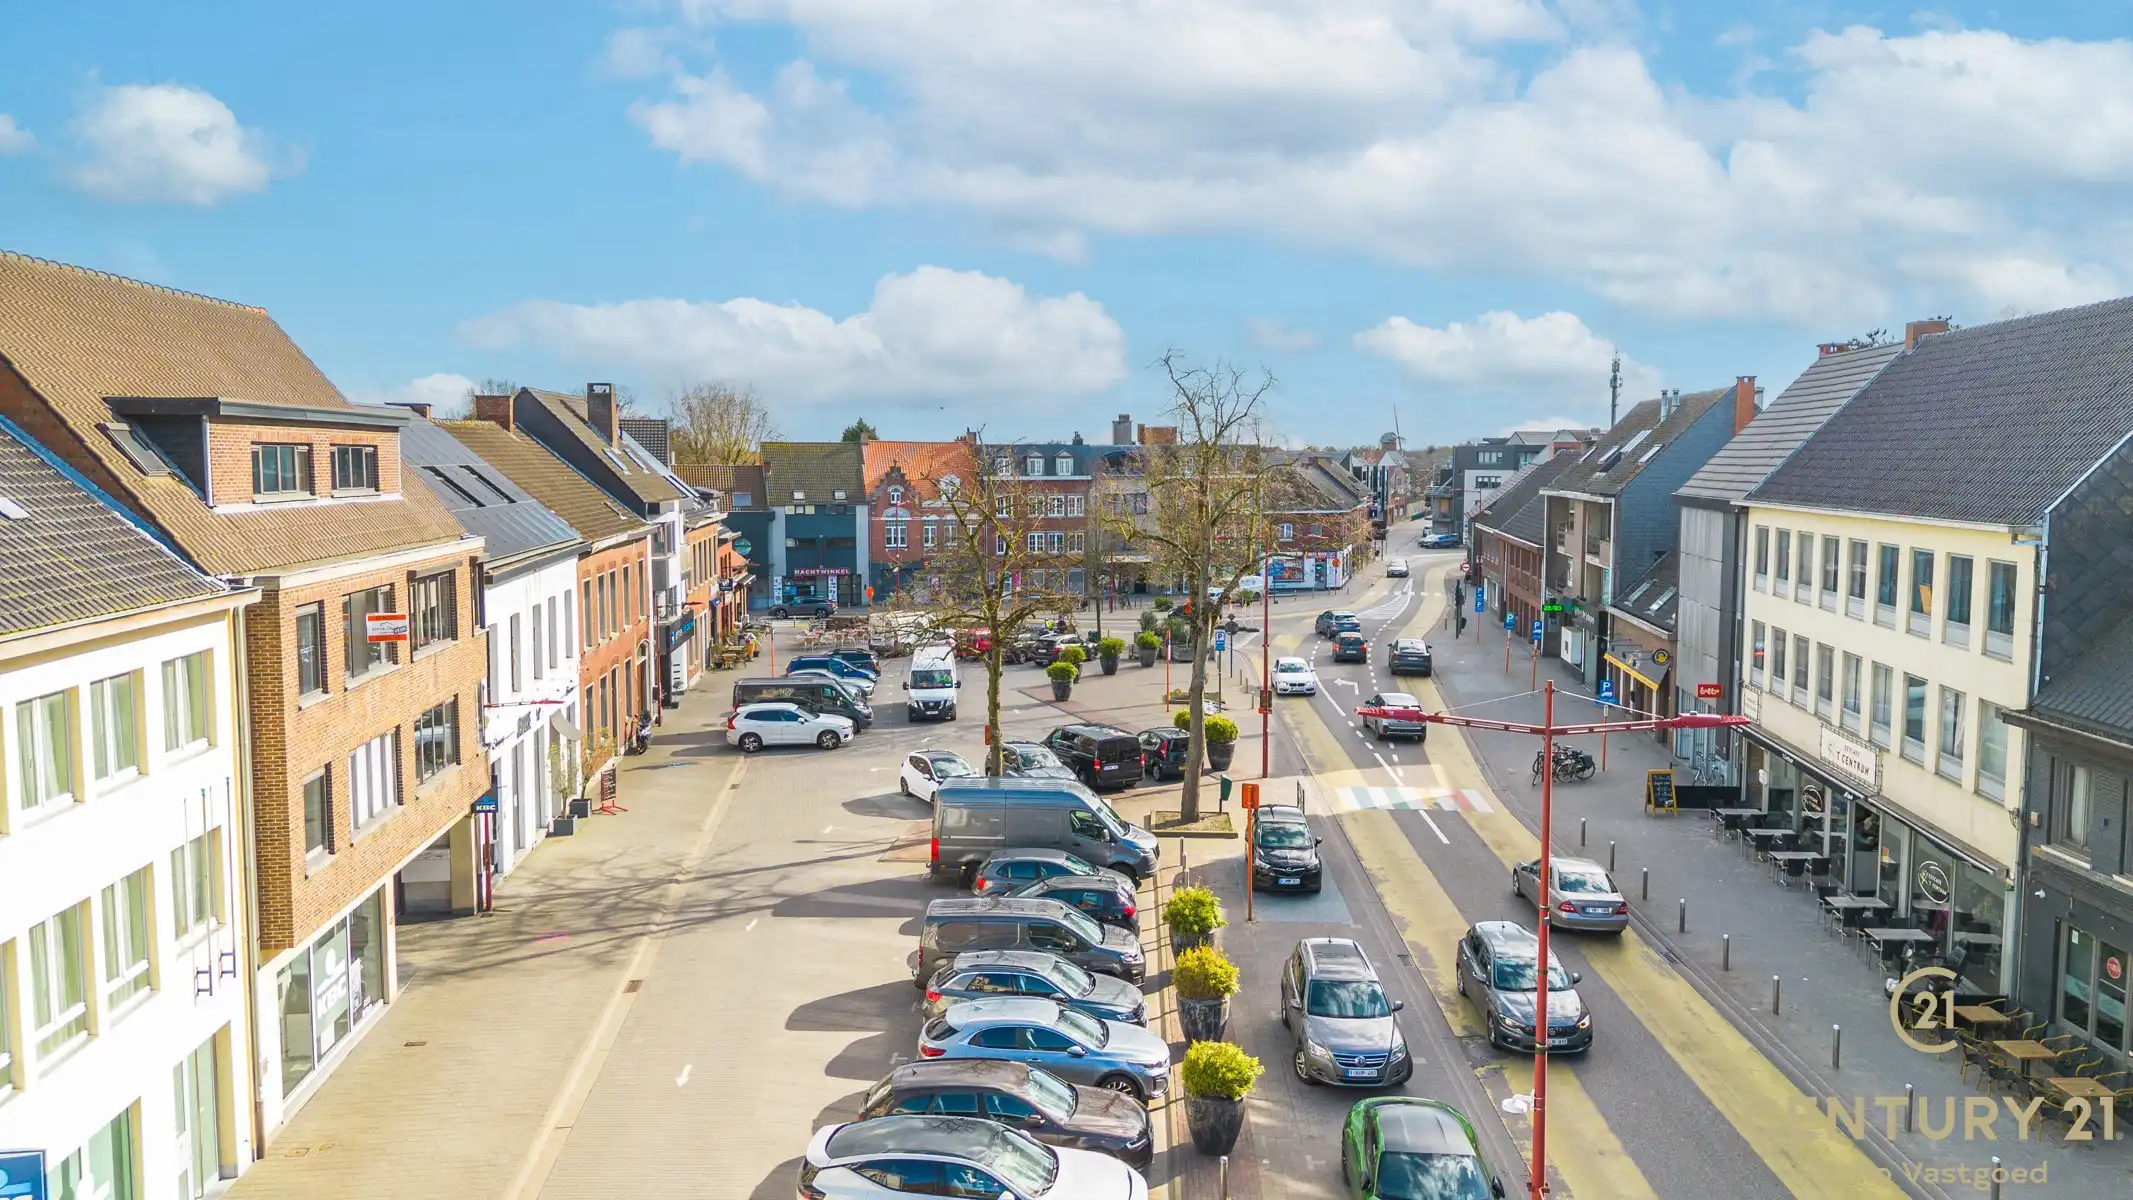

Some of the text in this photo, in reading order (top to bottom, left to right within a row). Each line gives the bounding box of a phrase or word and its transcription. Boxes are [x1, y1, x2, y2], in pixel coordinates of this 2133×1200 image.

[1506, 613, 1514, 623] P
[1534, 621, 1540, 629] P
[1603, 681, 1611, 691] P
[1841, 754, 1870, 776] CENTRUM
[316, 975, 347, 1019] KBC
